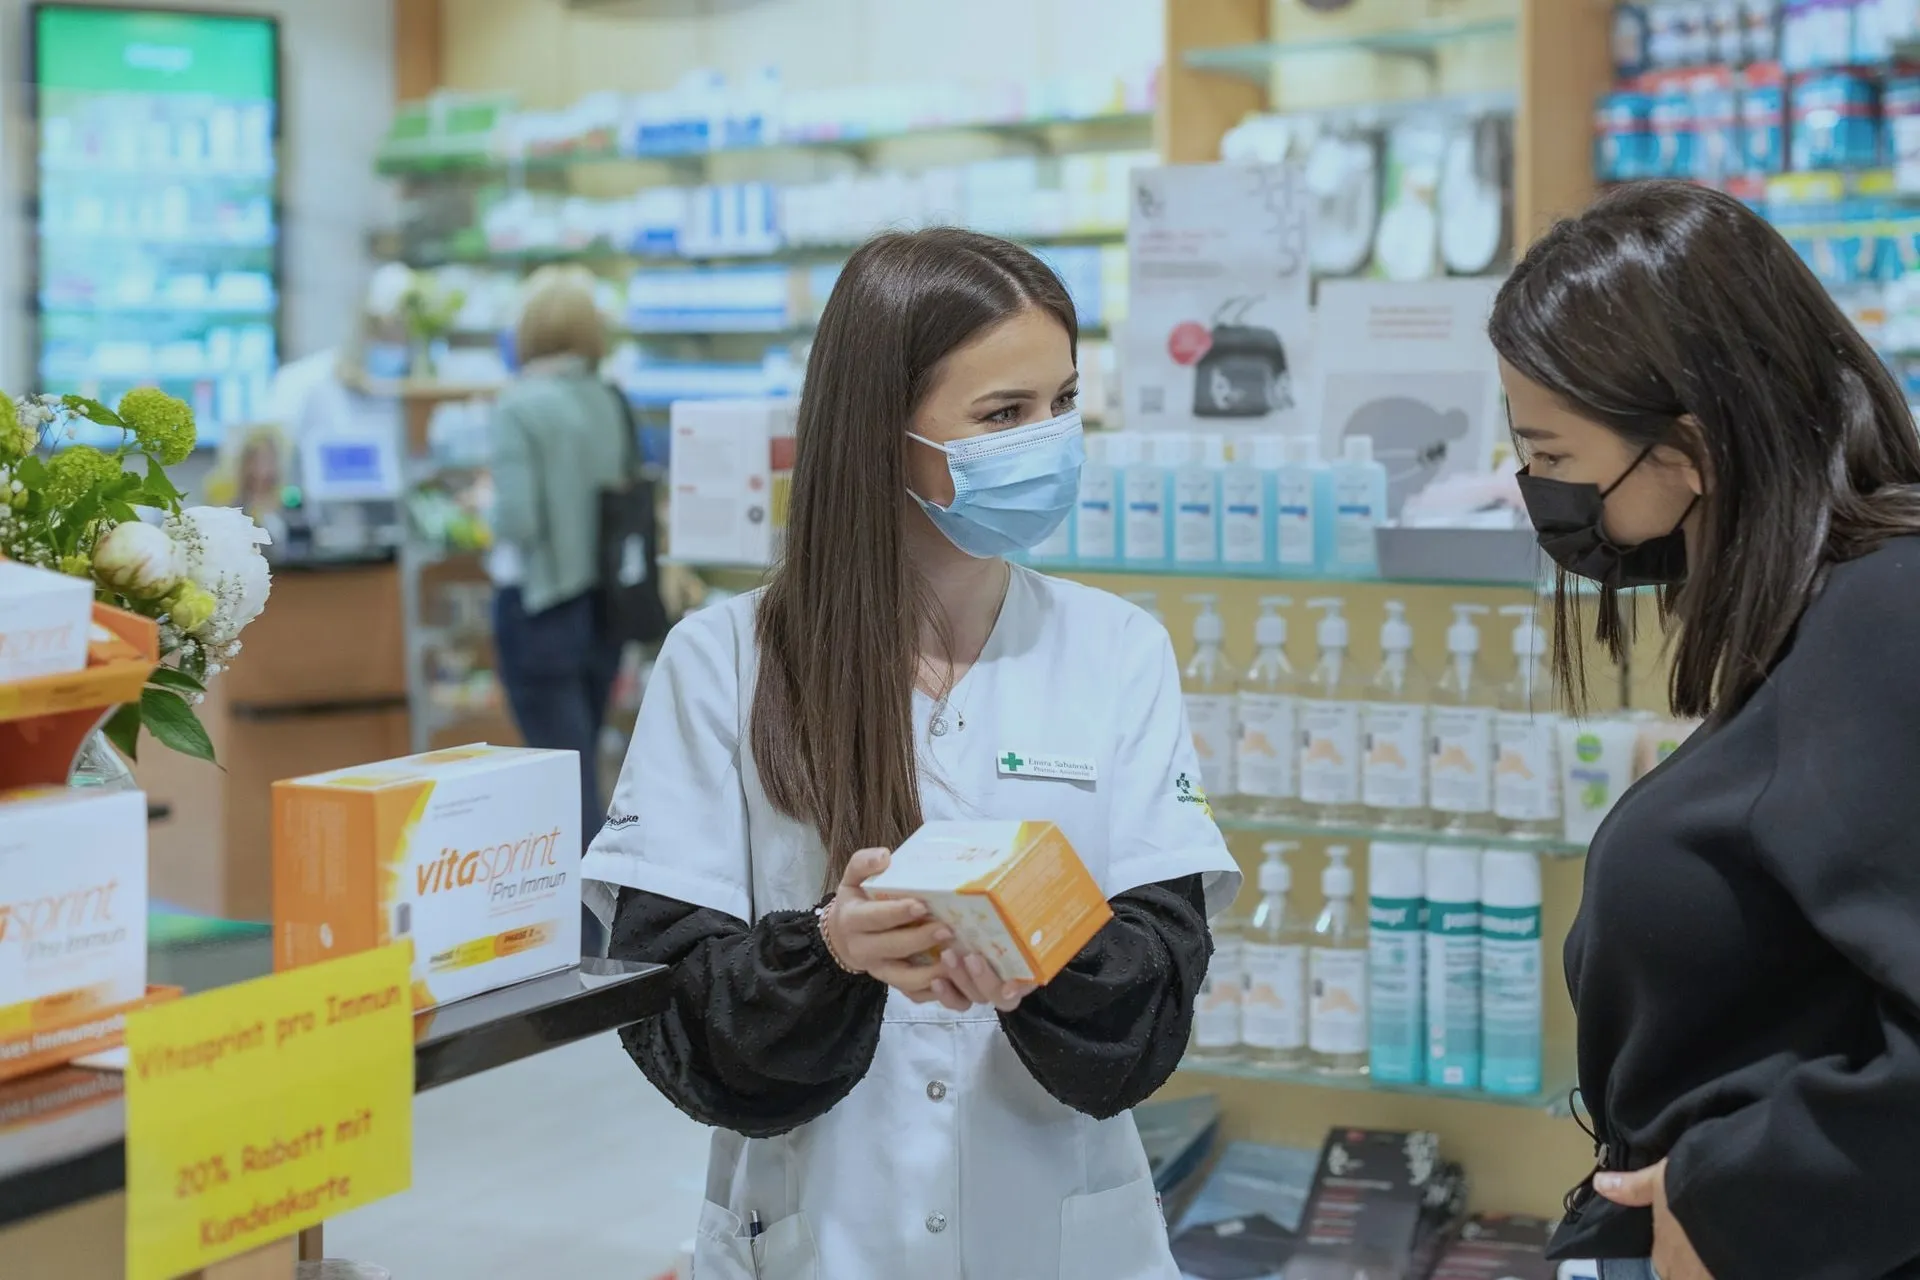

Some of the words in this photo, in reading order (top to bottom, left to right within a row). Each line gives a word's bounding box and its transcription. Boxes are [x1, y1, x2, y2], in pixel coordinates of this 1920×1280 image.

[416, 825, 561, 897] vitasprint
[491, 882, 518, 902] Pro
[519, 871, 567, 898] Immun
[135, 1019, 264, 1082] Vitasprint
[275, 1010, 316, 1049] pro
[325, 984, 401, 1026] Immun
[176, 1154, 230, 1199] 20%
[241, 1123, 325, 1175] Rabatt
[335, 1109, 373, 1144] mit
[200, 1174, 351, 1248] Kundenkarte
